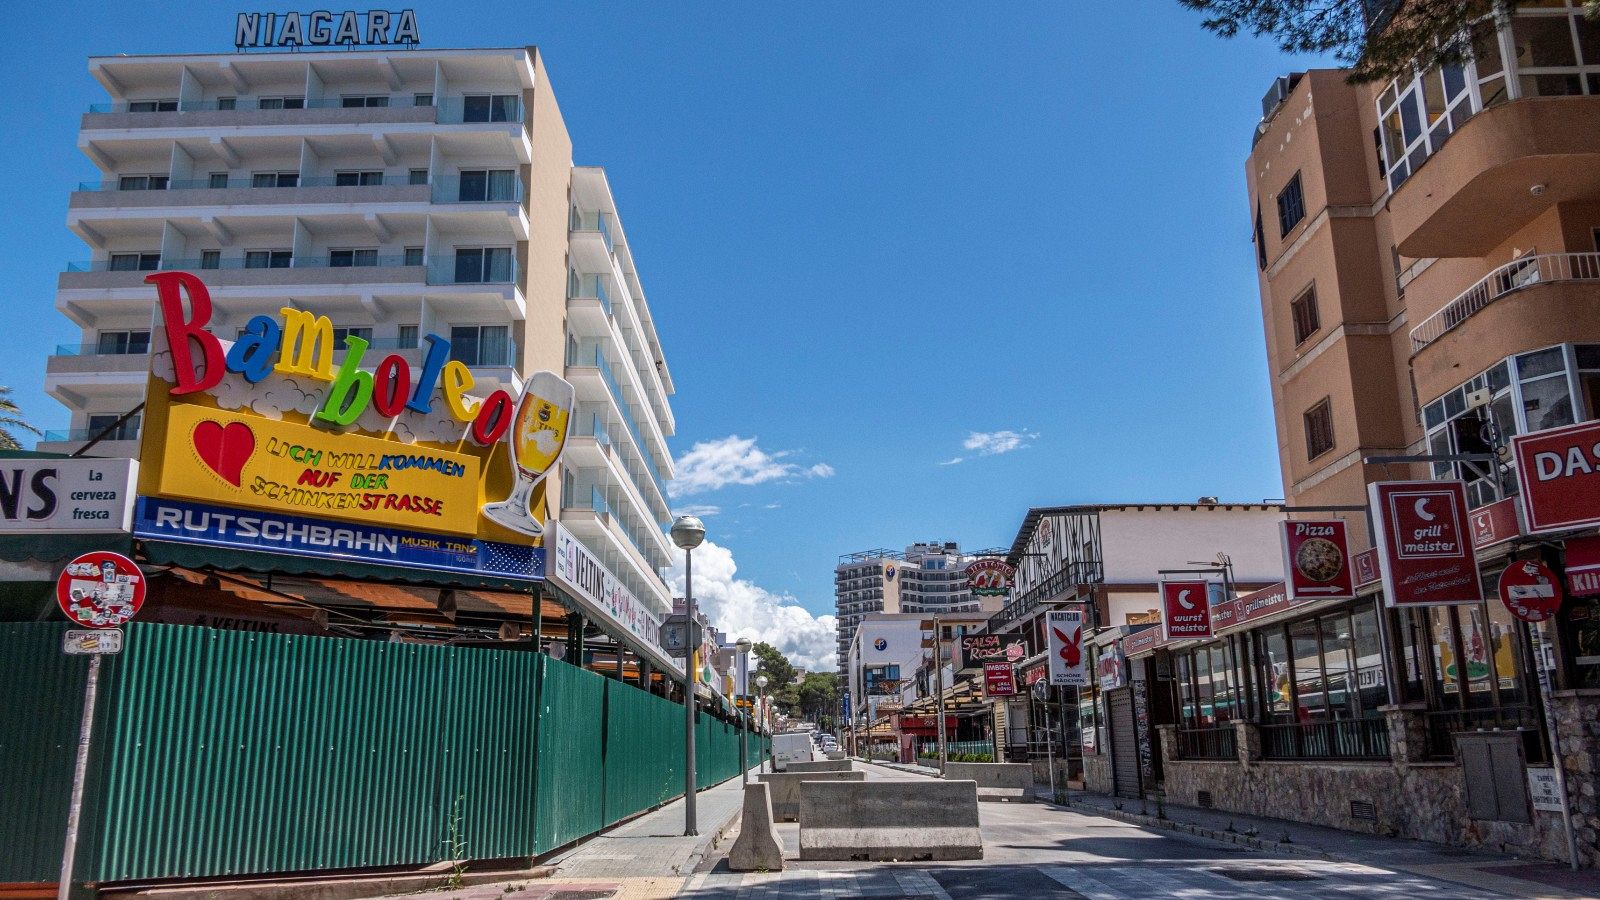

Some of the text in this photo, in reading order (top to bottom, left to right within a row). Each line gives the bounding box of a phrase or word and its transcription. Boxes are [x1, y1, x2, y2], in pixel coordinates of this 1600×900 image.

[235, 9, 420, 47] NIAGARA
[145, 270, 514, 446] Bamboleo
[266, 436, 466, 477] LICH WILLKOMMEN
[89, 469, 102, 481] La
[297, 469, 389, 490] AUF DER
[70, 491, 116, 500] cerveza
[250, 475, 444, 516] SCHINKENSTRASSE
[72, 507, 110, 519] fresca
[156, 506, 398, 554] RUTSCHBAHN
[1295, 523, 1335, 536] Pizza
[1414, 525, 1441, 540] grill
[401, 536, 477, 554] MUSIK TANZ
[1404, 541, 1455, 552] meister
[576, 546, 605, 603] VELTINS
[1572, 572, 1600, 591] Kli
[1245, 593, 1285, 614] grillmeister
[1174, 613, 1203, 622] wurst
[1171, 623, 1208, 632] meister
[963, 635, 1000, 650] SALSA
[970, 647, 1002, 660] ROSA
